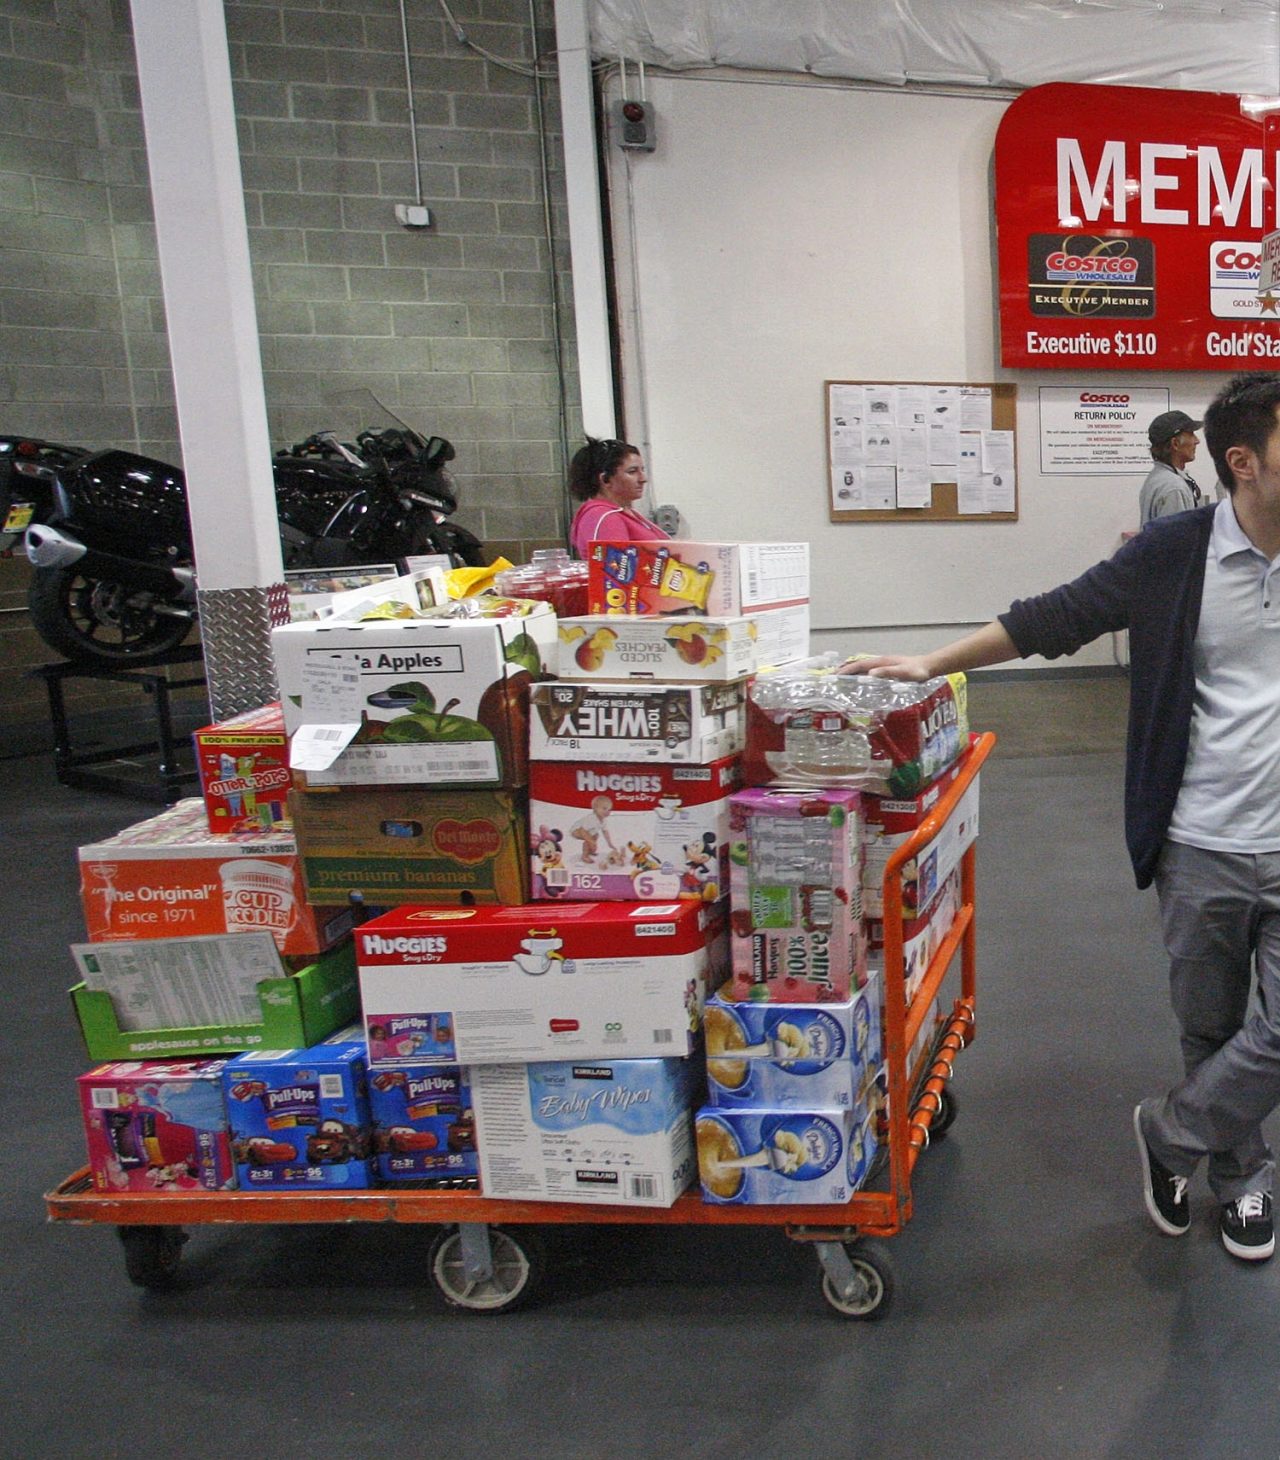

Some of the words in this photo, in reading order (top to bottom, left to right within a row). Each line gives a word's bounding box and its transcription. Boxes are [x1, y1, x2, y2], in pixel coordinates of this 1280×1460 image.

[1047, 252, 1138, 273] COSTCO
[1076, 272, 1135, 281] WHOLESALE
[1035, 295, 1098, 305] EXECUTIVE
[1102, 296, 1149, 306] MEMBER
[1233, 300, 1253, 308] GOLD
[1027, 332, 1110, 354] Executive
[1114, 331, 1157, 357] $110
[1206, 332, 1248, 356] Gold
[1080, 392, 1130, 403] COSTCO
[1074, 411, 1106, 420] RETURN
[1108, 411, 1137, 420] POLICY
[617, 554, 628, 581] Doritos
[651, 557, 663, 586] Doritos
[615, 642, 667, 652] PEACHES
[377, 653, 442, 671] Apples
[620, 653, 662, 662] SLICED
[583, 700, 610, 708] SHAKE
[610, 700, 644, 708] PROTEIN
[557, 707, 649, 737] WHEY
[648, 708, 660, 737] 100%
[231, 736, 255, 744] FRUIT
[569, 740, 580, 749] 18
[255, 768, 289, 788] POPS
[576, 770, 662, 792] HUGGIES
[436, 830, 457, 844] Del
[460, 830, 497, 844] Monte
[317, 867, 400, 885] premium
[404, 868, 477, 883] bananas
[574, 875, 601, 889] 162
[639, 877, 654, 896] 5
[236, 891, 283, 909] CUP
[118, 910, 158, 923] since
[163, 909, 196, 921] 1971
[363, 934, 448, 955] HUGGIES
[753, 935, 763, 982] KIRKLAND
[786, 935, 807, 977] 100%
[808, 934, 833, 990] Juice
[391, 1018, 428, 1034] Pull-Ups
[130, 1038, 199, 1051] applesauce
[203, 1037, 219, 1046] on
[223, 1035, 242, 1046] the
[246, 1034, 262, 1045] go
[574, 1068, 612, 1076] KIRKLAND
[409, 1078, 455, 1098] Pull-Ups
[269, 1088, 315, 1108] Pull-Ups
[539, 1092, 591, 1120] Baby
[592, 1086, 652, 1112] Wipes
[448, 1155, 463, 1164] 96
[307, 1168, 322, 1177] 96
